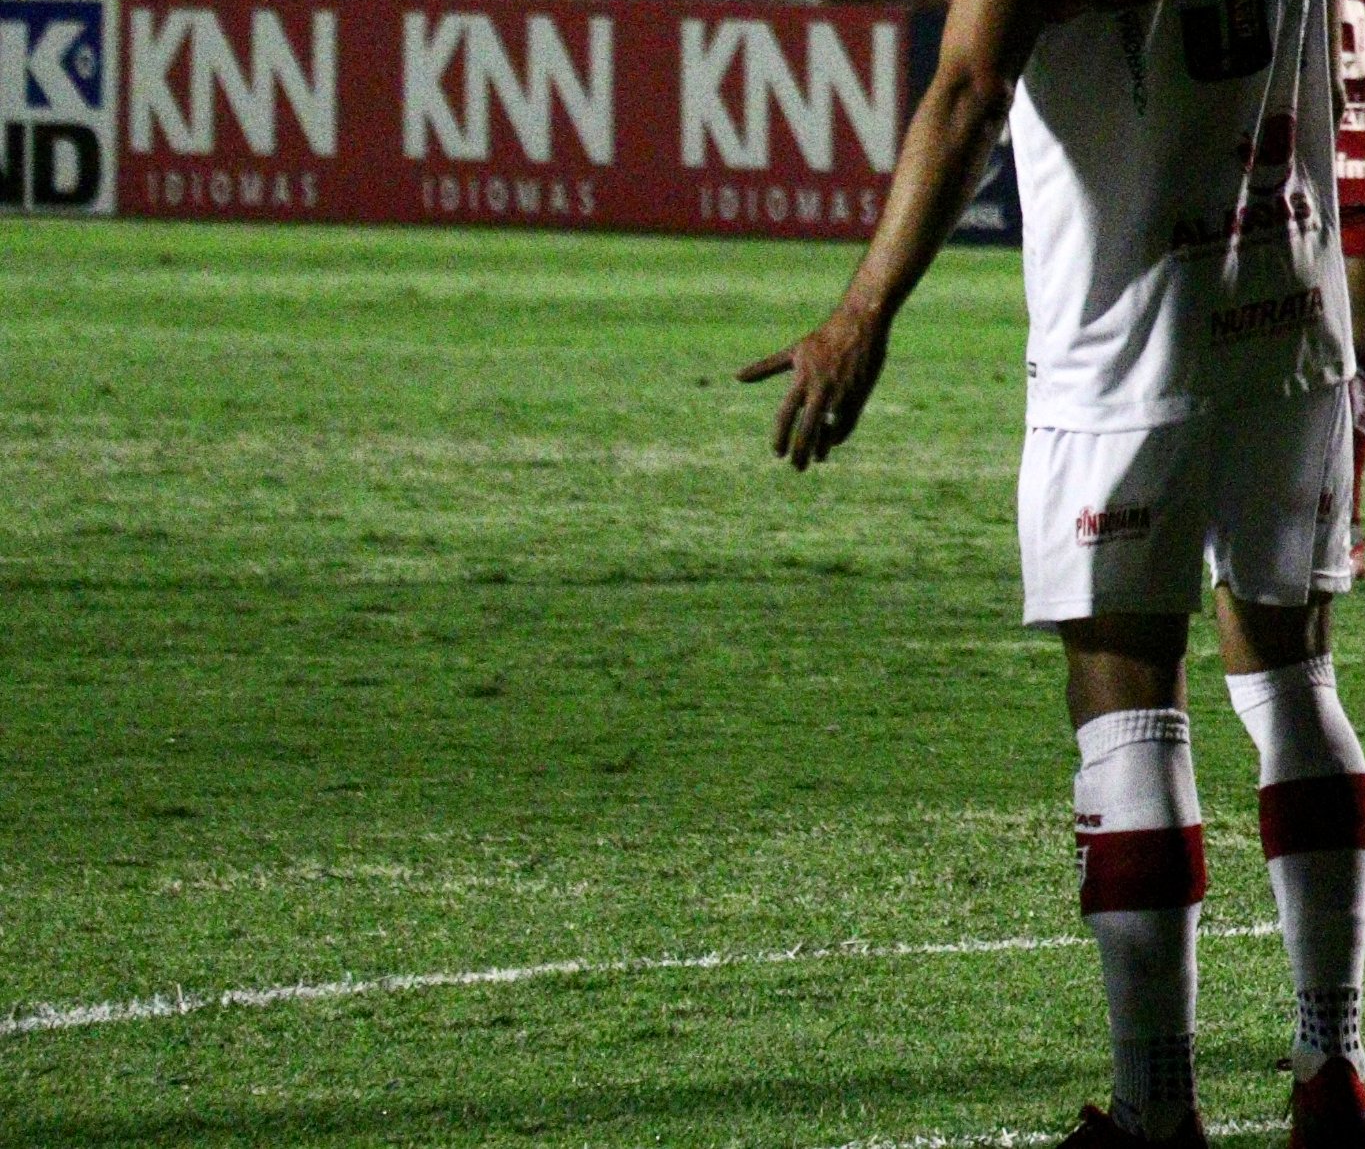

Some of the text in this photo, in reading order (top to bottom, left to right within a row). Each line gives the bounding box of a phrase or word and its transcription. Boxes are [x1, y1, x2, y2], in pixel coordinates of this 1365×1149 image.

[130, 9, 337, 157] KNN
[404, 12, 614, 165] KNN
[680, 17, 899, 174] KNN
[144, 170, 319, 208] IDIOMAS
[422, 175, 599, 216] IDIOMAS
[698, 185, 880, 227] IDIOMAS
